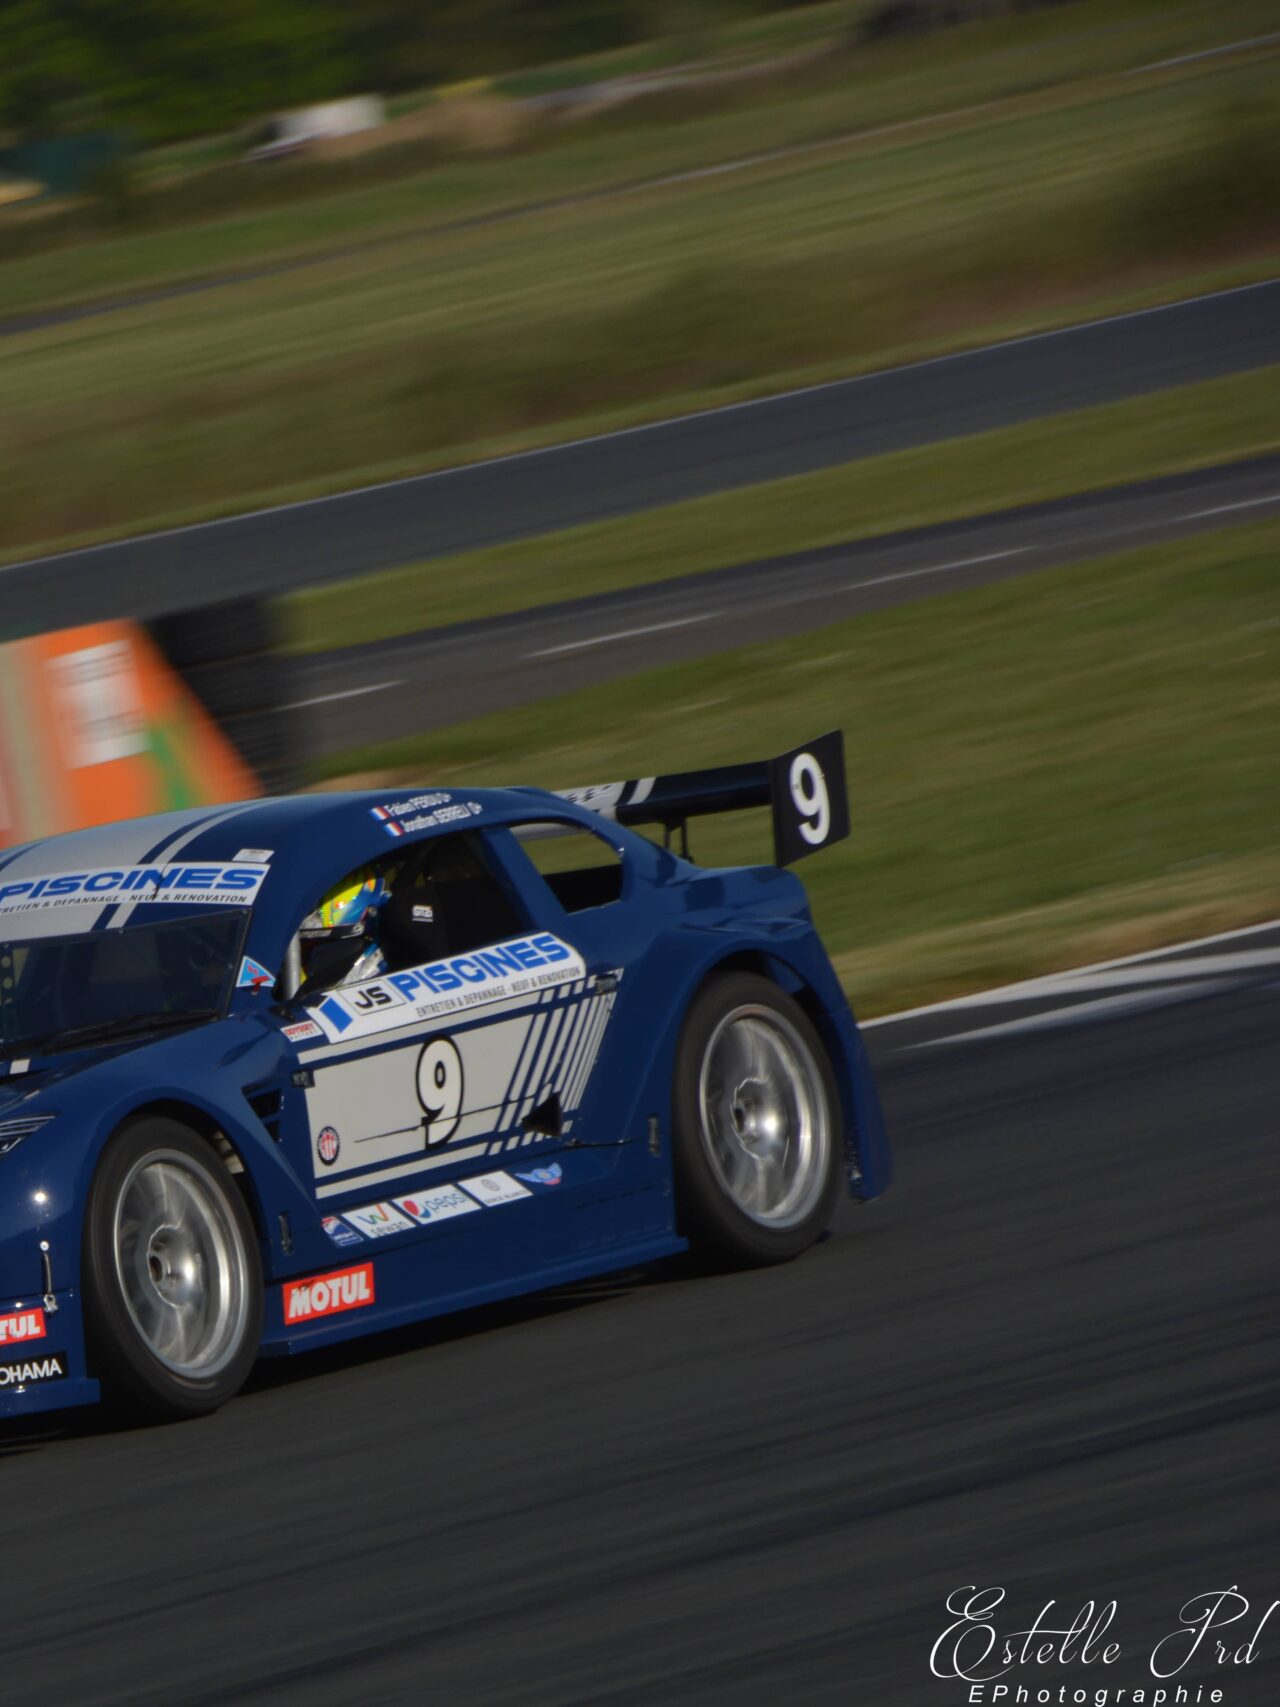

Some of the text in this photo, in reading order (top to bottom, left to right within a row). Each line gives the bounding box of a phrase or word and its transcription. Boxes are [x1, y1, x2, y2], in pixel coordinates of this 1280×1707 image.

[789, 752, 831, 845] 9
[53, 894, 120, 907] DEPANNAGE
[174, 893, 248, 903] RENOVATION
[353, 934, 571, 1010] JS PISCINES
[416, 996, 456, 1018] ENTRETIEN
[464, 985, 506, 1007] DEPANNAGE
[511, 980, 530, 993] NEUF
[537, 966, 581, 988] RENOVATION
[415, 1034, 464, 1151] 9
[425, 1190, 467, 1213] pepsi
[289, 1271, 370, 1318] MOTUL
